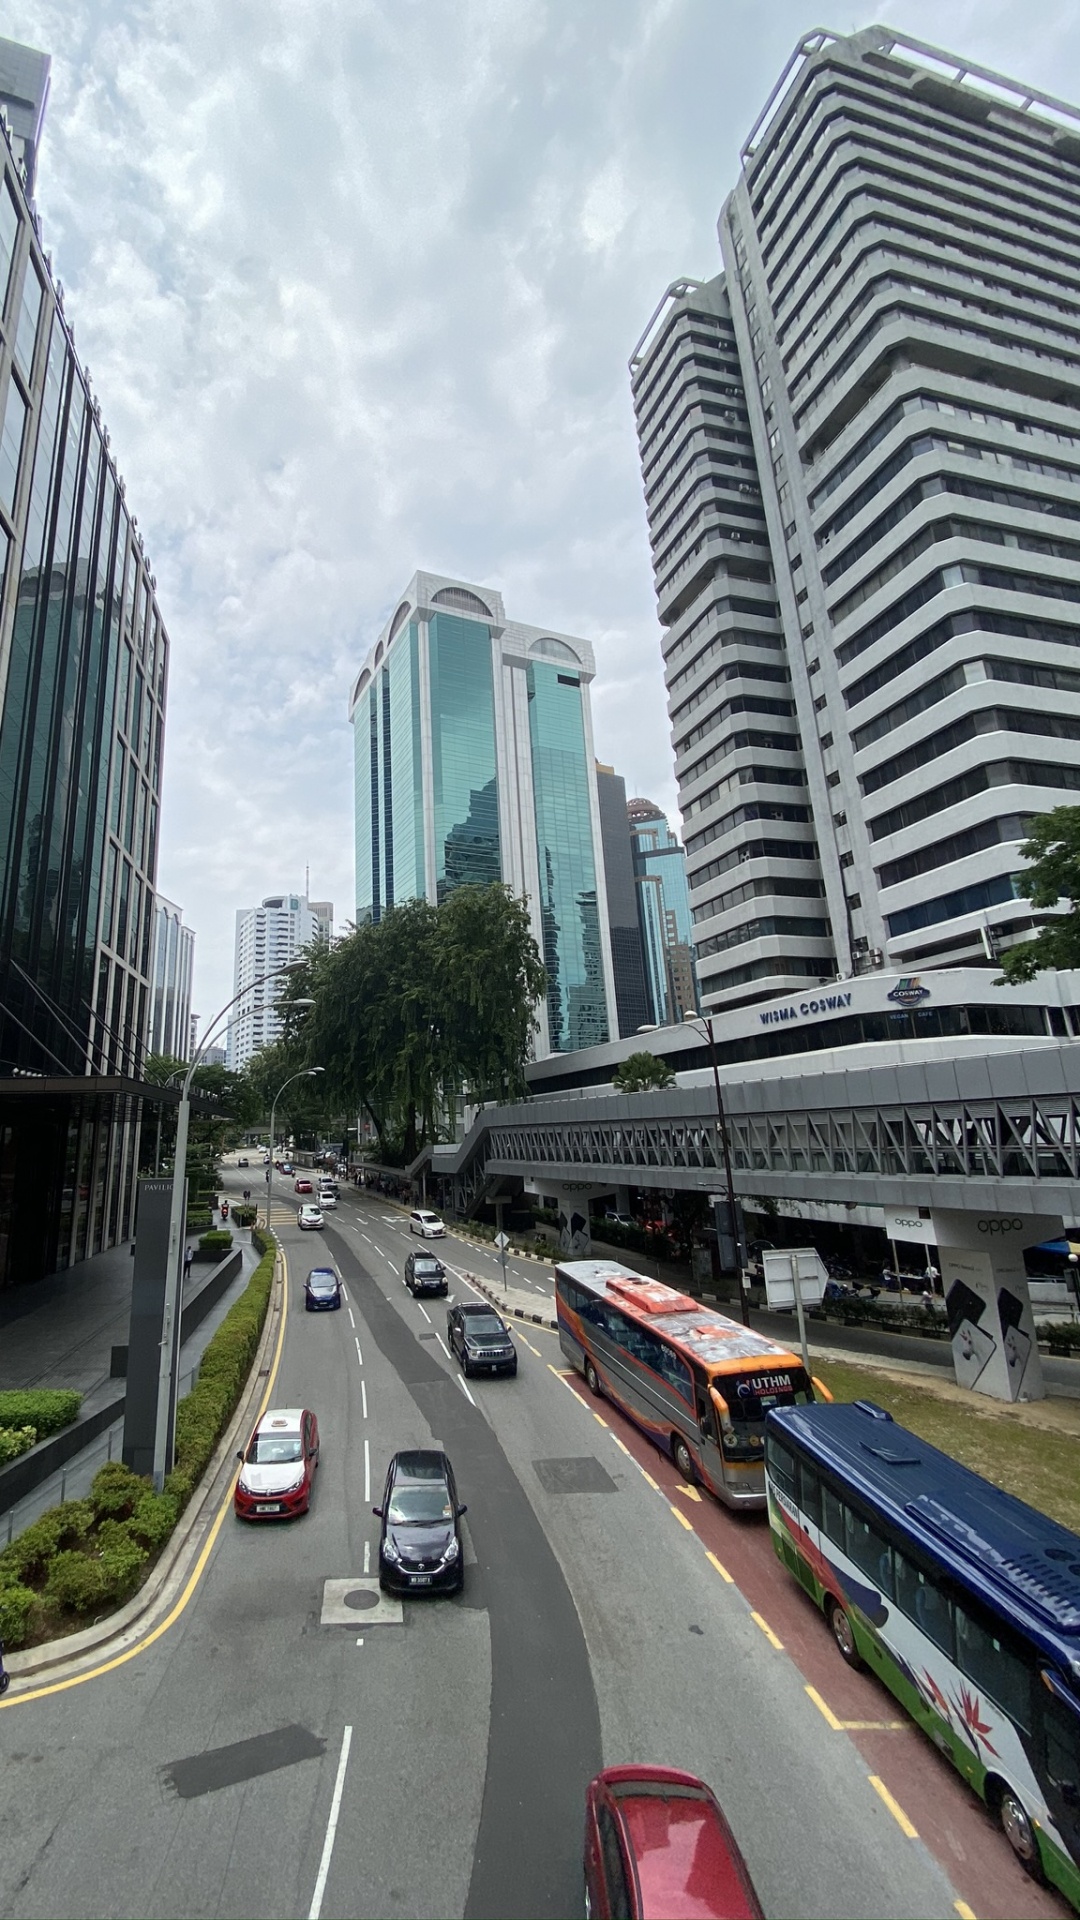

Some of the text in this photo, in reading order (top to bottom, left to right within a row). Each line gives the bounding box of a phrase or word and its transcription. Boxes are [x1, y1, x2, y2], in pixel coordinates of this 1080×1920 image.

[892, 989, 923, 998] COSWAY
[759, 992, 852, 1025] WISMA COSWAY
[894, 1218, 923, 1228] oppo
[977, 1218, 1023, 1236] oppo
[752, 1374, 792, 1389] UTHM
[754, 1386, 794, 1396] HOLDINGS
